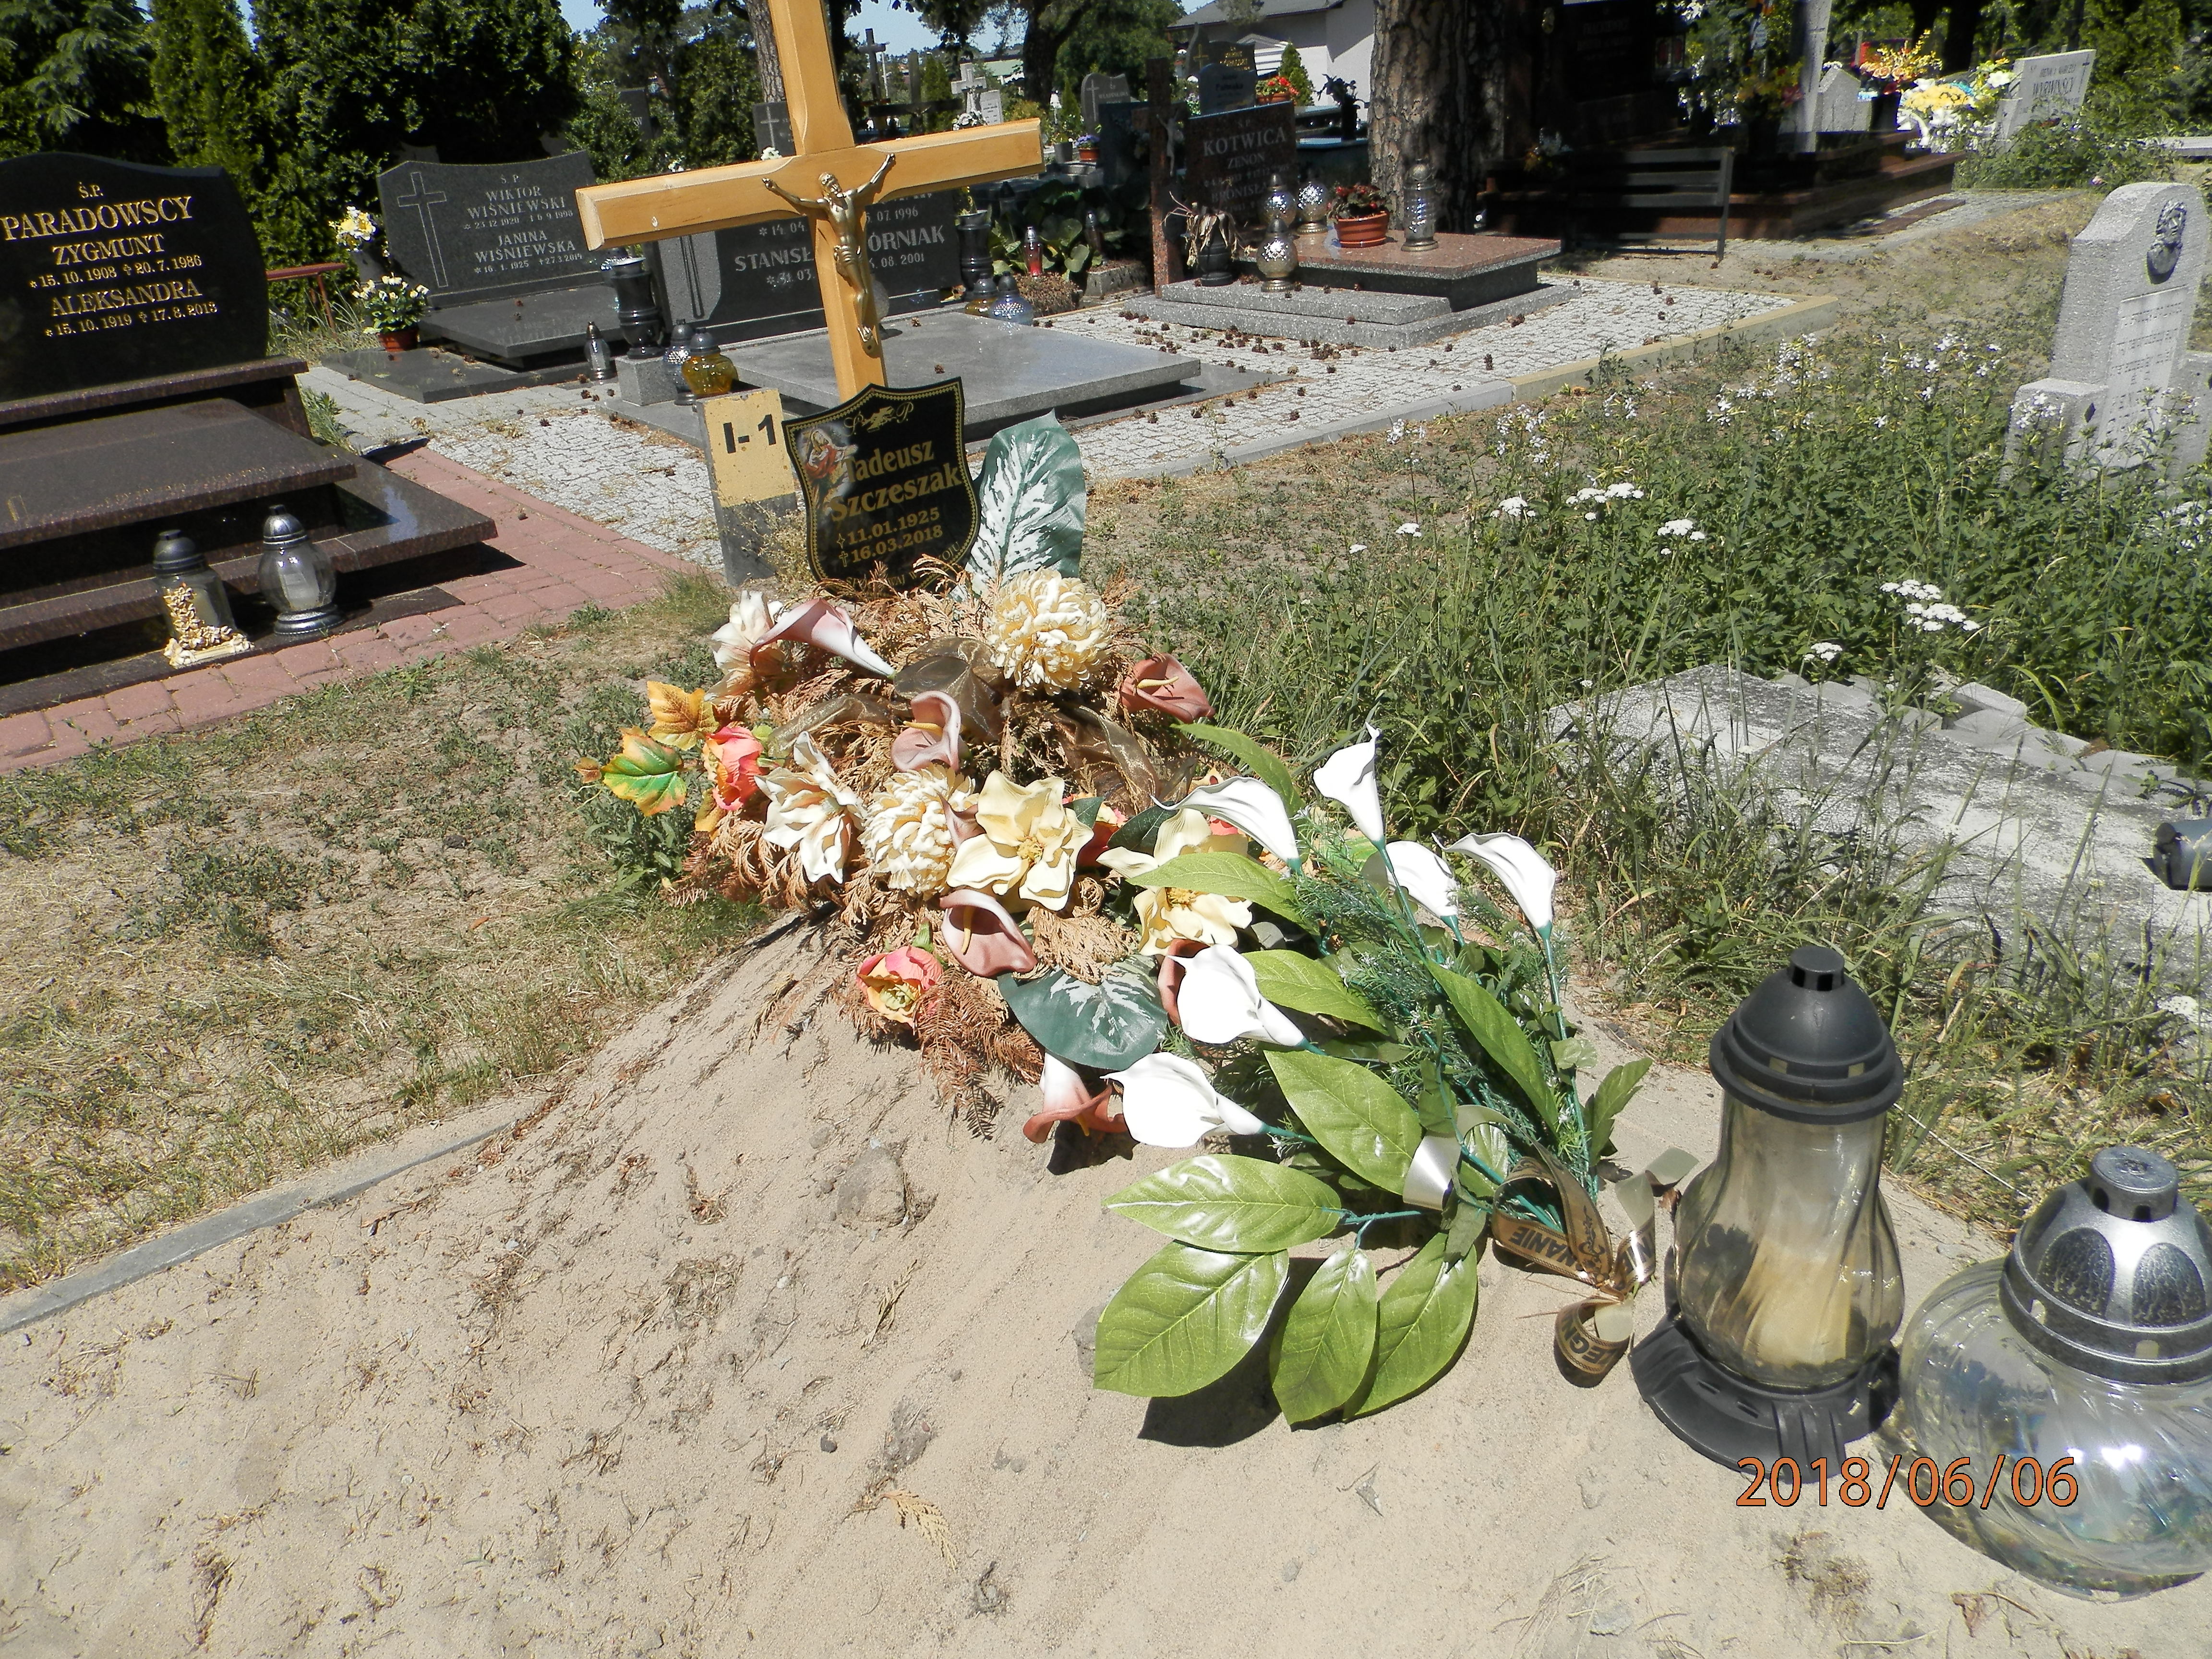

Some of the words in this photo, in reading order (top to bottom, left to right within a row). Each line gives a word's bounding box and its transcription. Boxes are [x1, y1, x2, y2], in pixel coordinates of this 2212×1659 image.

[1203, 127, 1286, 156] KOTWICA
[467, 196, 565, 219] WIŚNIEWSKI
[484, 186, 541, 202] WIKTOR
[0, 196, 193, 240] PARADOWSCY
[895, 206, 918, 219] 1996
[52, 234, 165, 265] ZYGMUNT
[474, 240, 576, 263] WIŚNIEWSKA
[498, 230, 547, 246] JANINA
[734, 247, 814, 271] STANISŁ
[868, 225, 945, 252] ÓRNIAK
[86, 266, 117, 281] 1908
[172, 255, 202, 269] 1986
[901, 252, 924, 264] 2001
[51, 278, 203, 316] ALEKSANDRA
[102, 315, 132, 329] 1919
[187, 302, 219, 315] 2013
[842, 440, 934, 482] Tadeusz
[830, 463, 962, 522] Szczeszak
[847, 507, 939, 545] 11.01.1925
[851, 525, 943, 563] 16.03.2018
